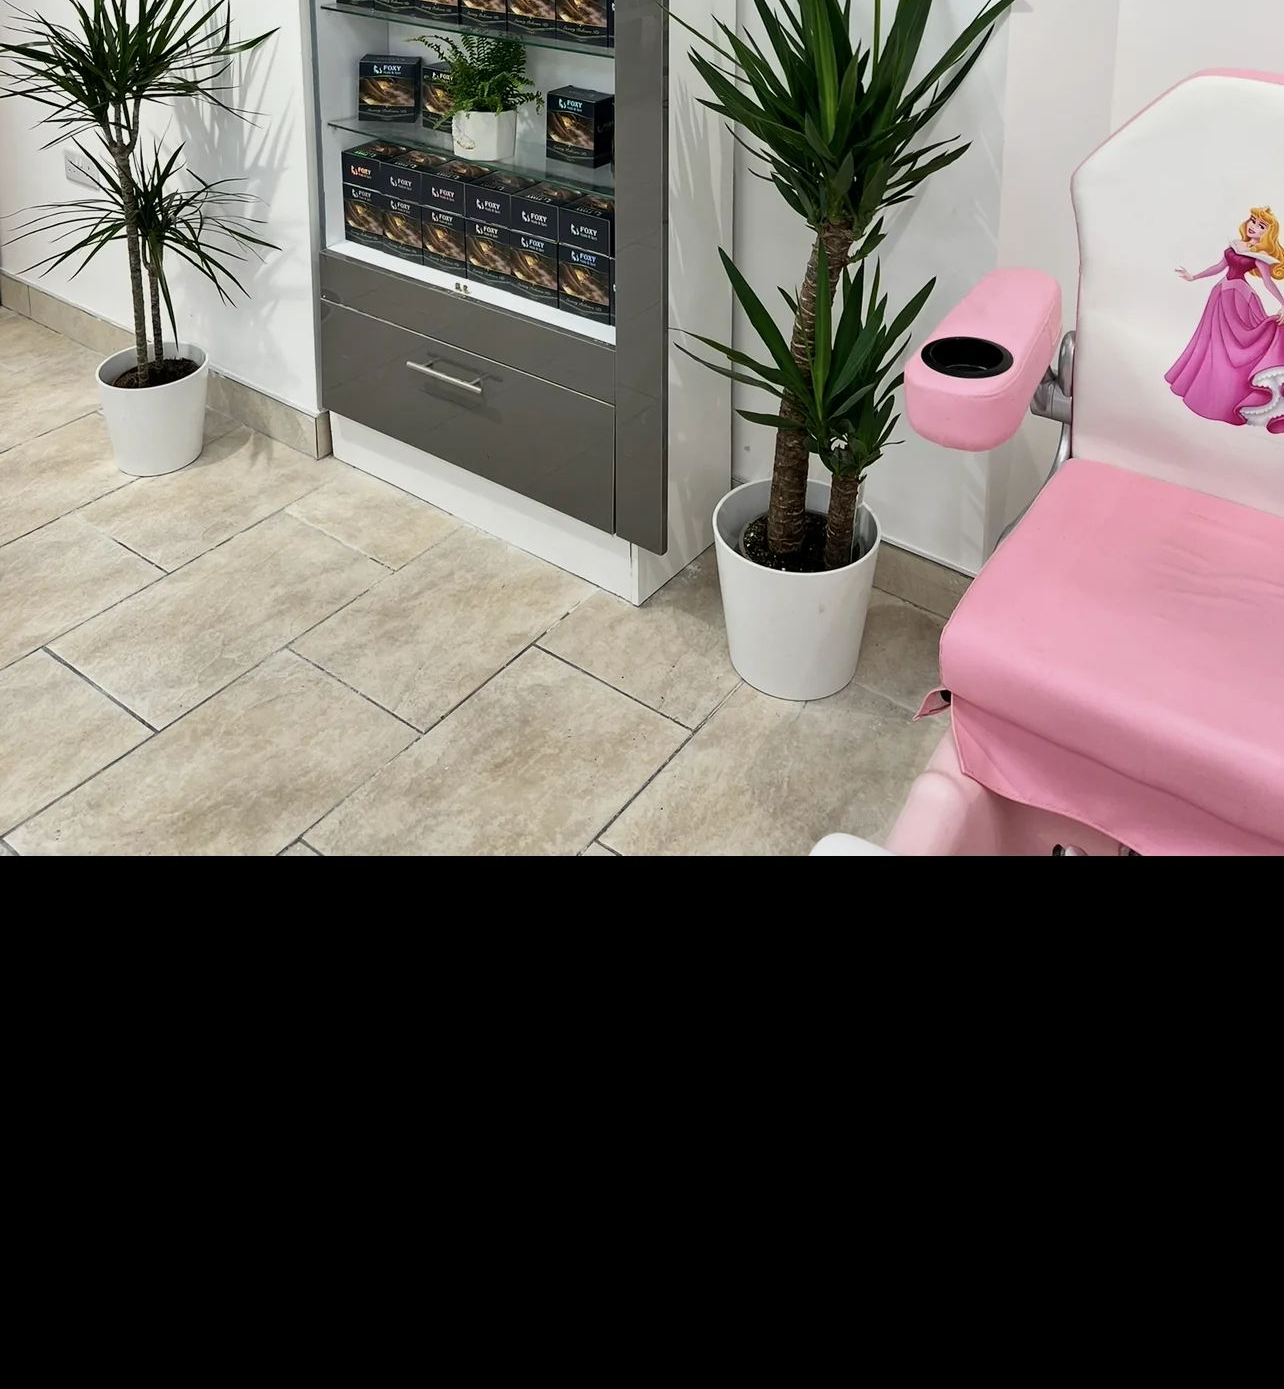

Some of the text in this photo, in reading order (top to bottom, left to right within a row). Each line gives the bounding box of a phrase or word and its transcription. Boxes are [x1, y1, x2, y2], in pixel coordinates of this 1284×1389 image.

[567, 100, 583, 108] FOXY
[357, 167, 371, 175] FOXY
[398, 178, 412, 186] FOXY
[358, 190, 371, 198] FOXY
[439, 189, 454, 197] FOXY
[397, 202, 410, 210] FOXY
[485, 201, 500, 210] FOXY
[439, 214, 453, 222] FOXY
[531, 213, 547, 222] FOXY
[483, 226, 498, 234] FOXY
[580, 226, 597, 236] FOXY
[530, 239, 544, 248] FOXY
[580, 253, 596, 262] FOXY
